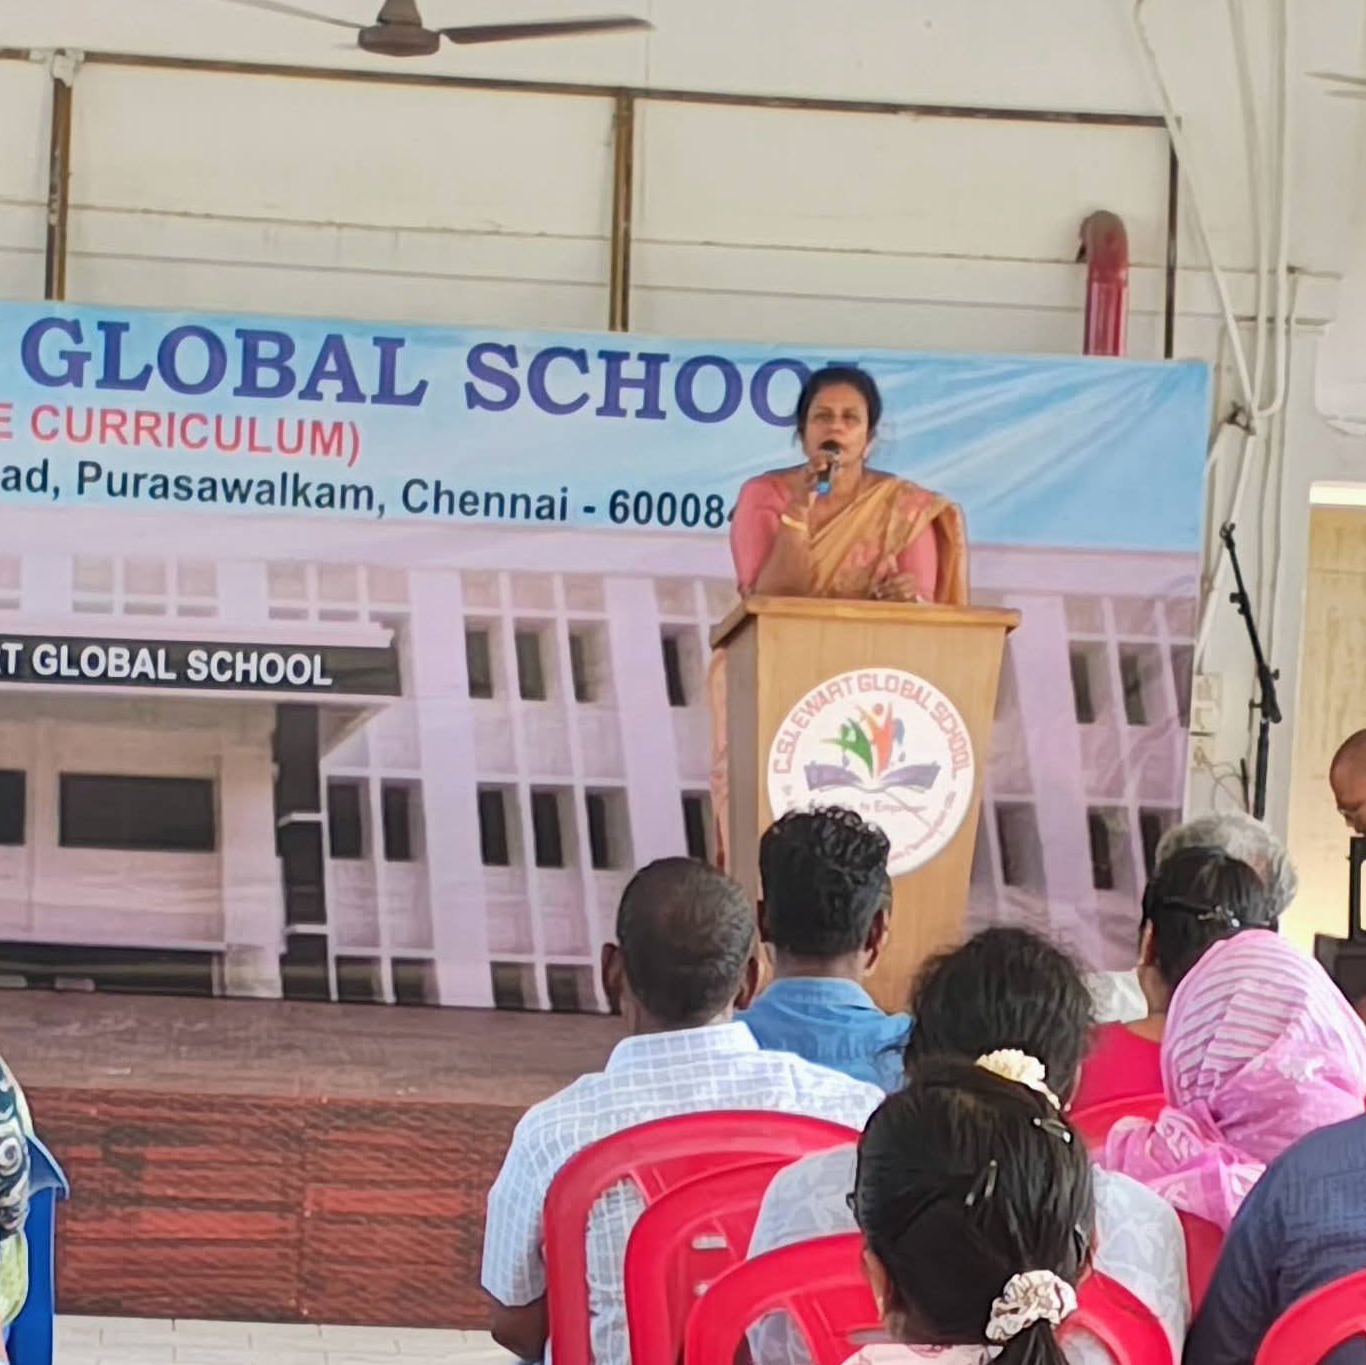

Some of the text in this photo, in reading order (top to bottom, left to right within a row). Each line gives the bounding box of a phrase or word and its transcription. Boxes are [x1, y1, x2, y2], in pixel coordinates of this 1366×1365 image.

[20, 316, 429, 407] GLOBAL
[464, 342, 859, 428] SCHOO
[30, 406, 361, 465] CURRICULUM)
[77, 460, 386, 517] Purasawalkam,
[402, 478, 568, 521] Chennai
[583, 505, 596, 514] -
[609, 489, 736, 529] 60008
[32, 643, 177, 681] GLOBAL
[186, 649, 334, 687] SCHOOL
[790, 676, 854, 730] EWART
[856, 672, 933, 711] GLOBAL
[928, 700, 971, 781] SCHOOL
